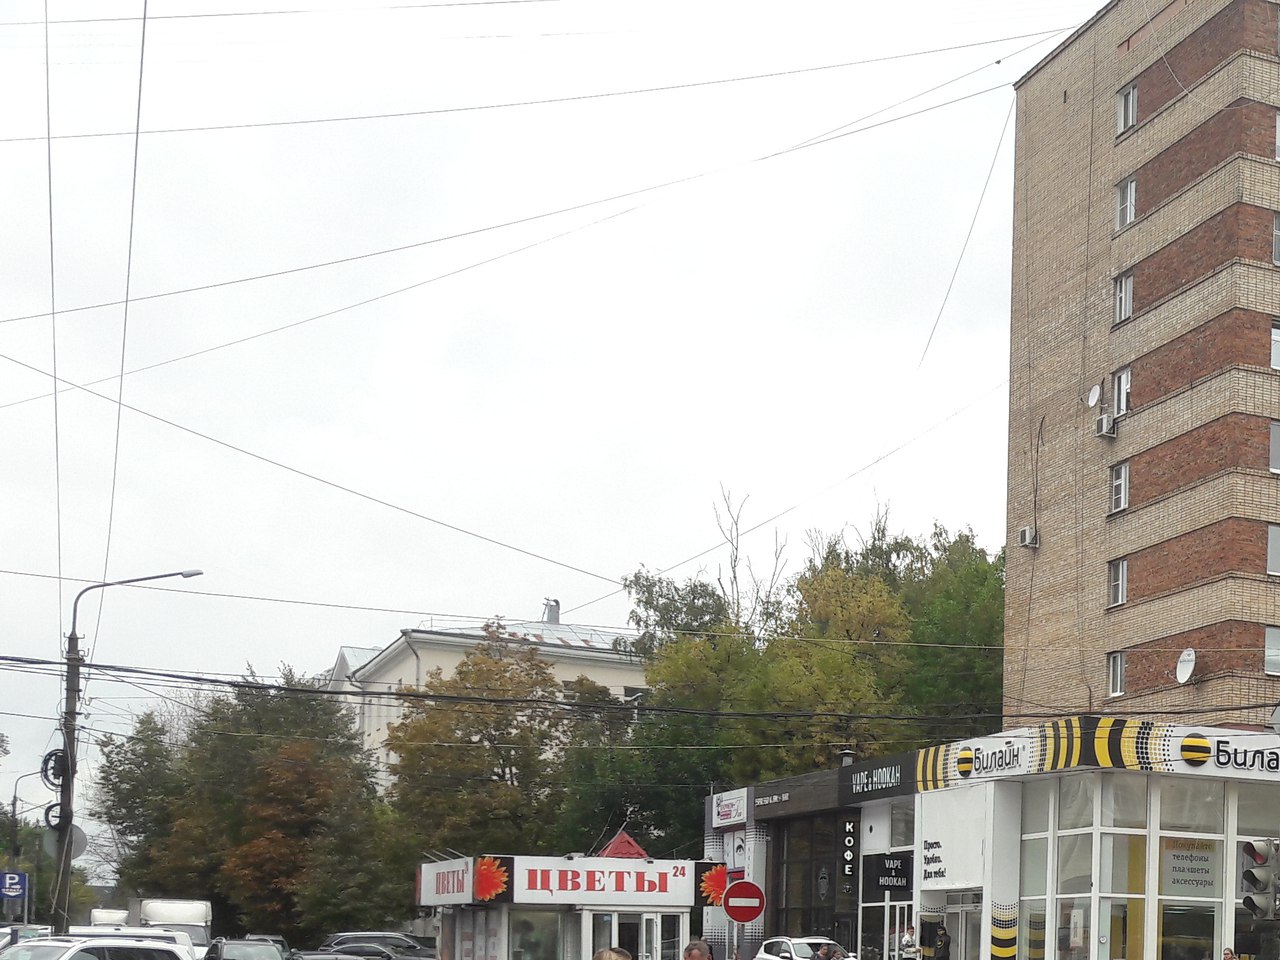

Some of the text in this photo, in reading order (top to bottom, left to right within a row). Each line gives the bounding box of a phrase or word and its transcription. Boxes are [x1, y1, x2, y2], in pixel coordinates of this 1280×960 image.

[852, 770, 868, 794] VAPE
[872, 765, 901, 792] HOOKAH
[844, 821, 855, 875] КОФЕ
[1172, 853, 1209, 863] телефоны
[885, 860, 902, 869] VAPE
[1172, 866, 1210, 874] планшеты
[436, 869, 465, 895] ЦВЕТЫ
[525, 866, 686, 896] ЦВЕТЫ 24
[879, 876, 907, 887] HOOKAH
[1172, 878, 1214, 888] аксессуары
